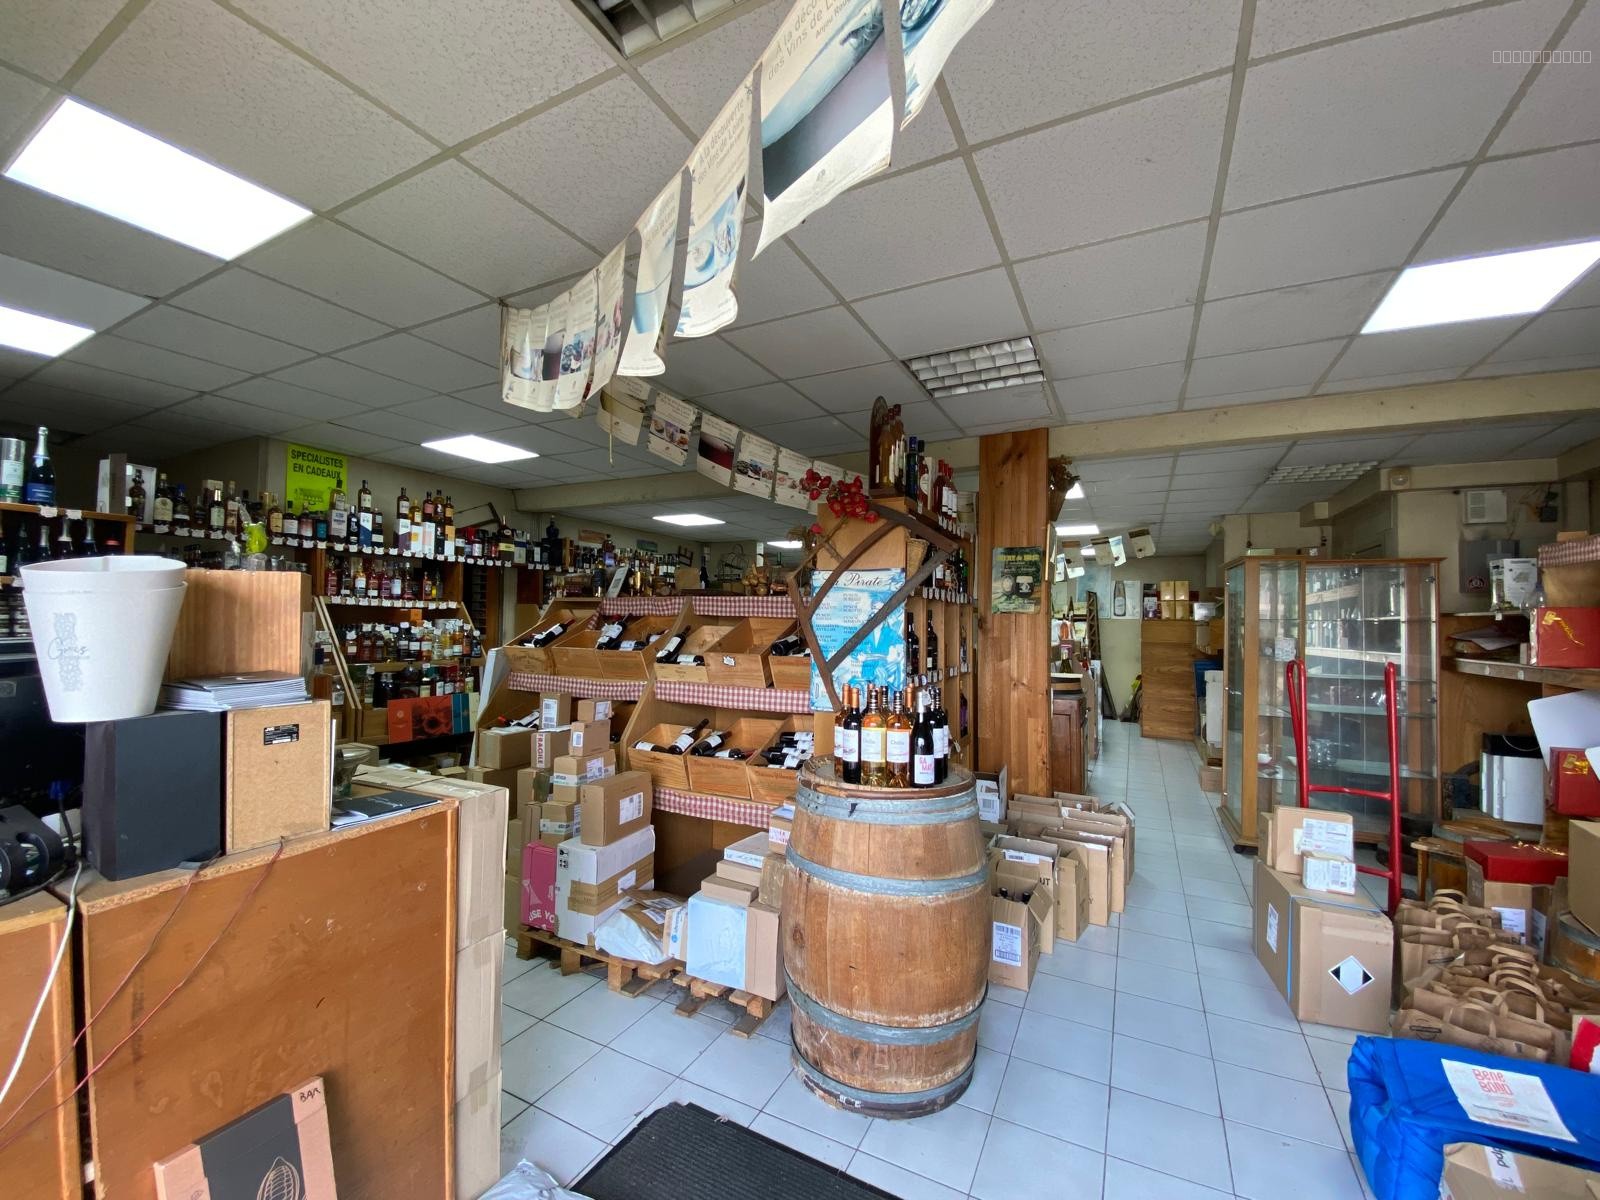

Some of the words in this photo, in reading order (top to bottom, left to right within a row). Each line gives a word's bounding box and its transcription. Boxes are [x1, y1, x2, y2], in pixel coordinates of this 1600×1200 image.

[768, 57, 785, 80] des
[786, 31, 808, 56] Vins
[810, 9, 823, 29] de
[783, 31, 793, 46] la
[290, 448, 344, 469] SPECIALISTES
[293, 462, 304, 473] EN
[305, 464, 341, 480] CADEAUX
